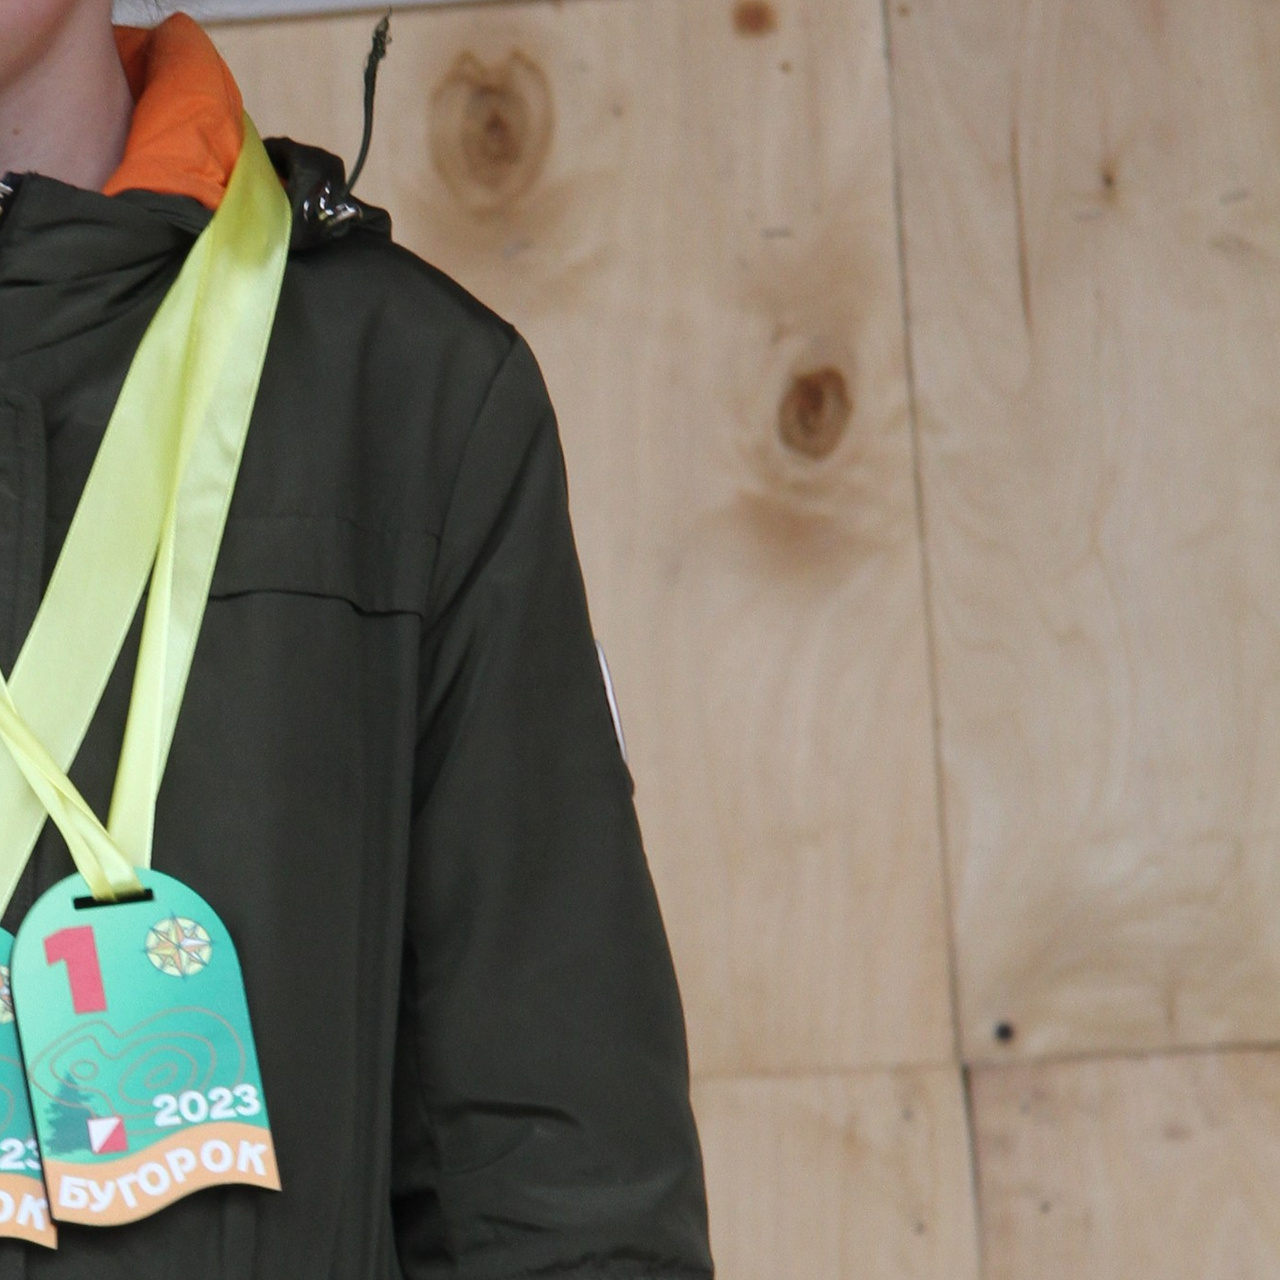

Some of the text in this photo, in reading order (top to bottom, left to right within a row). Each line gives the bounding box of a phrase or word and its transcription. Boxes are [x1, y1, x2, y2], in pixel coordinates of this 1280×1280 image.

[44, 925, 107, 1014] 1
[153, 1083, 261, 1127] 2023
[58, 1140, 268, 1212] БУГОРОК
